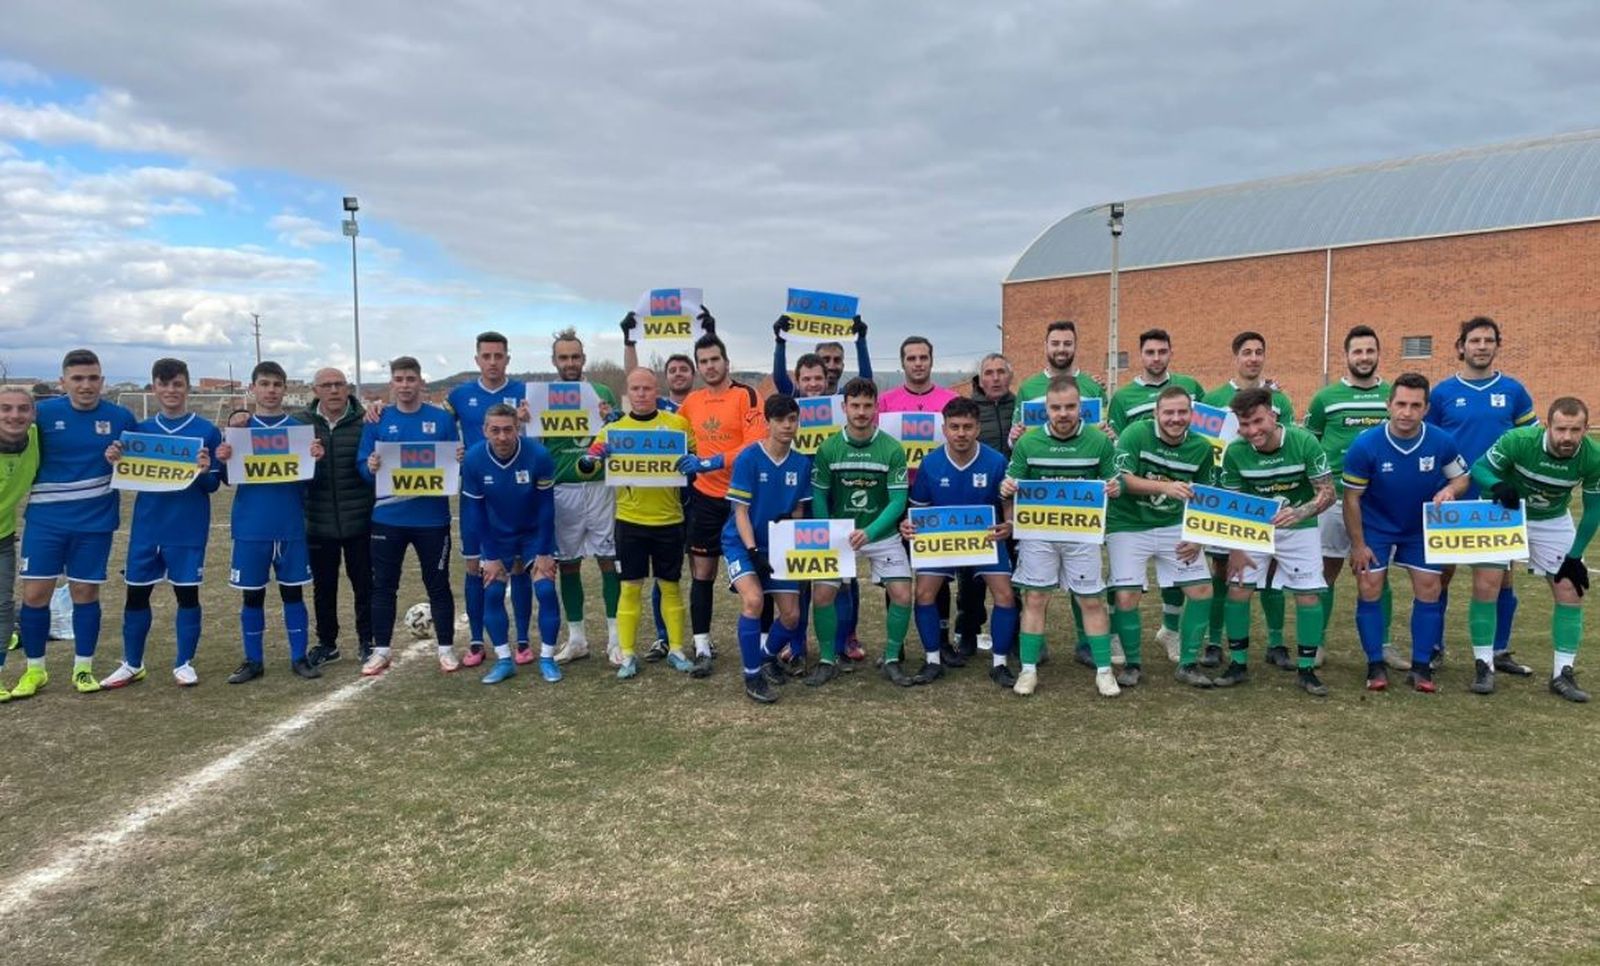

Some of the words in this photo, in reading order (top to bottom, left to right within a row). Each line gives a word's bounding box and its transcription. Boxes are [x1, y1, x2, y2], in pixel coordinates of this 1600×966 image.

[651, 296, 681, 311] NO
[788, 295, 812, 310] NO
[644, 321, 691, 335] WAR
[550, 392, 580, 405] NO
[800, 405, 832, 421] NO
[541, 416, 589, 431] WAR
[903, 420, 934, 436] NO
[121, 440, 146, 453] NO
[154, 443, 165, 454] A
[171, 446, 190, 456] LA
[253, 435, 288, 450] NO
[608, 436, 635, 449] NO
[643, 437, 652, 449] A
[659, 439, 676, 449] LA
[794, 432, 836, 449] WA
[402, 449, 435, 464] NO
[117, 462, 195, 480] GUERRA
[244, 462, 299, 477] WAR
[392, 475, 444, 490] WAR
[1017, 487, 1048, 500] NO
[1056, 488, 1067, 499] A
[1073, 488, 1095, 502] LA
[1190, 492, 1220, 508] NO
[1227, 500, 1238, 511] A
[1245, 502, 1266, 517] LA
[912, 514, 941, 529] NO
[947, 514, 958, 526] A
[964, 513, 984, 525] LA
[1017, 511, 1101, 528] GUERRA
[1427, 509, 1459, 524] NO
[1470, 510, 1481, 521] A
[1489, 510, 1512, 522] LA
[795, 528, 829, 544] NO
[1186, 516, 1271, 542] GUERRA
[913, 536, 994, 553] GUERRA
[1428, 533, 1524, 549] GUERRA
[786, 557, 838, 574] WAR
